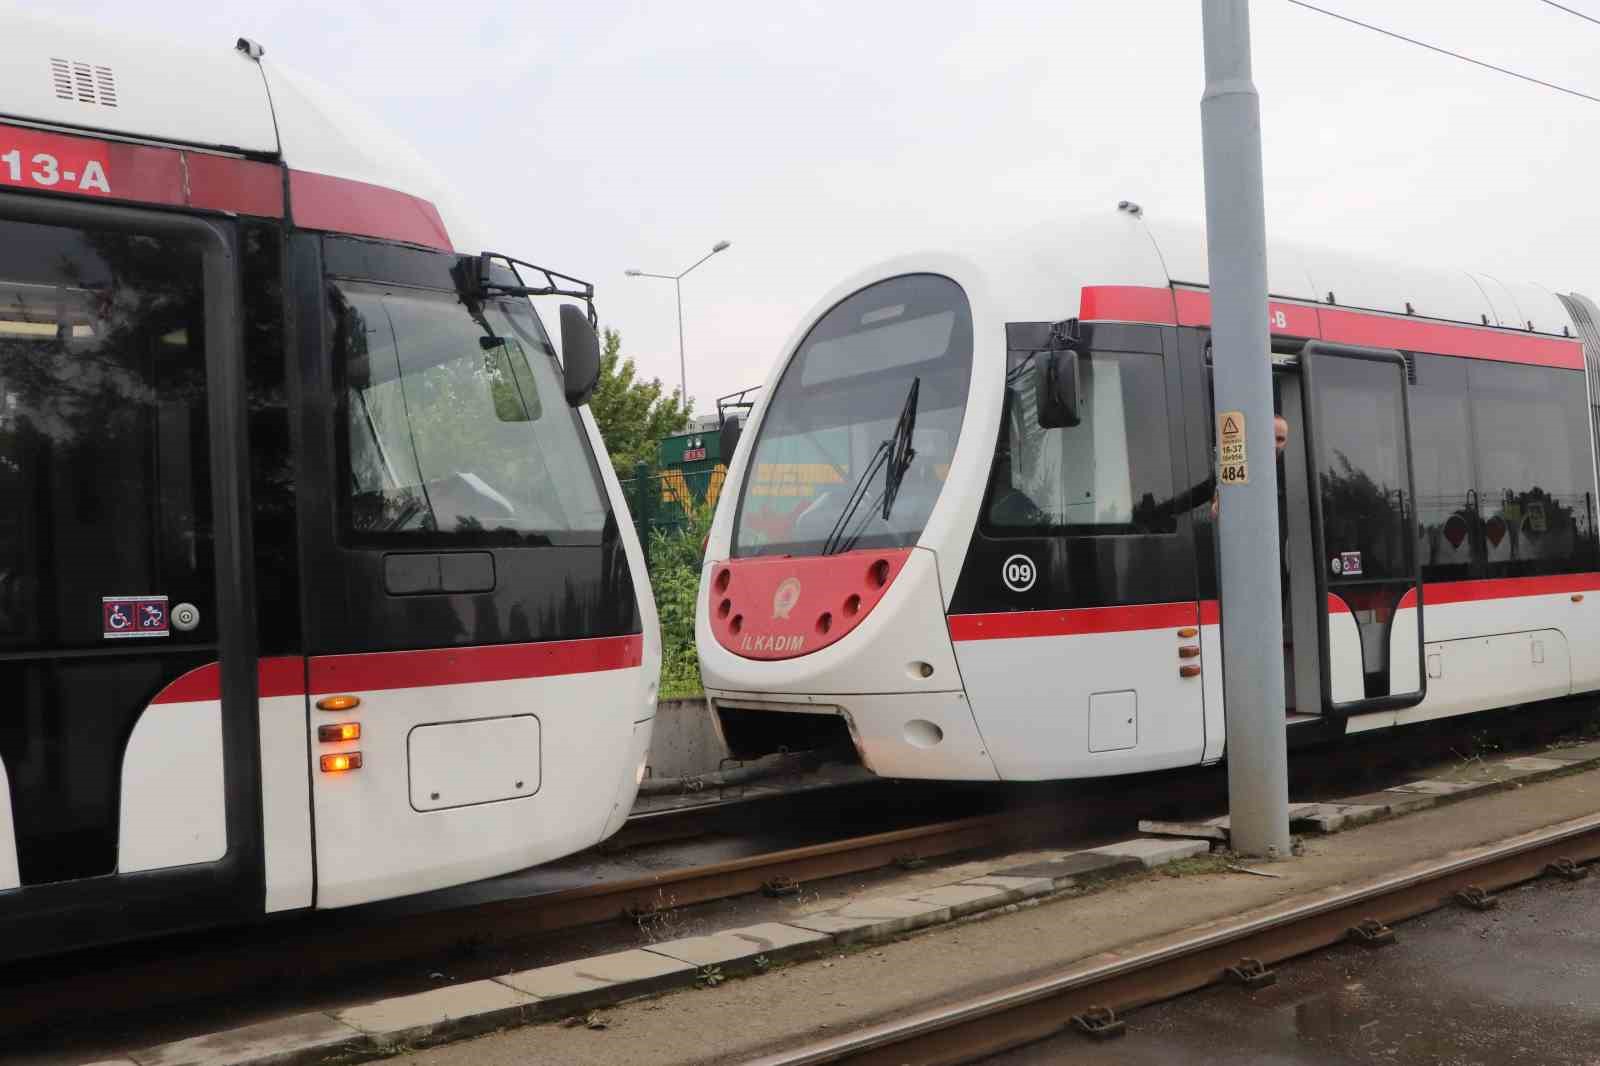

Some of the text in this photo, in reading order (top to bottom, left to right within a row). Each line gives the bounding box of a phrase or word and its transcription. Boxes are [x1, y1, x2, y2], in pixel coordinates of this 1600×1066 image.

[1, 149, 111, 193] 13-A
[1222, 465, 1245, 481] 484
[1008, 564, 1031, 582] 09
